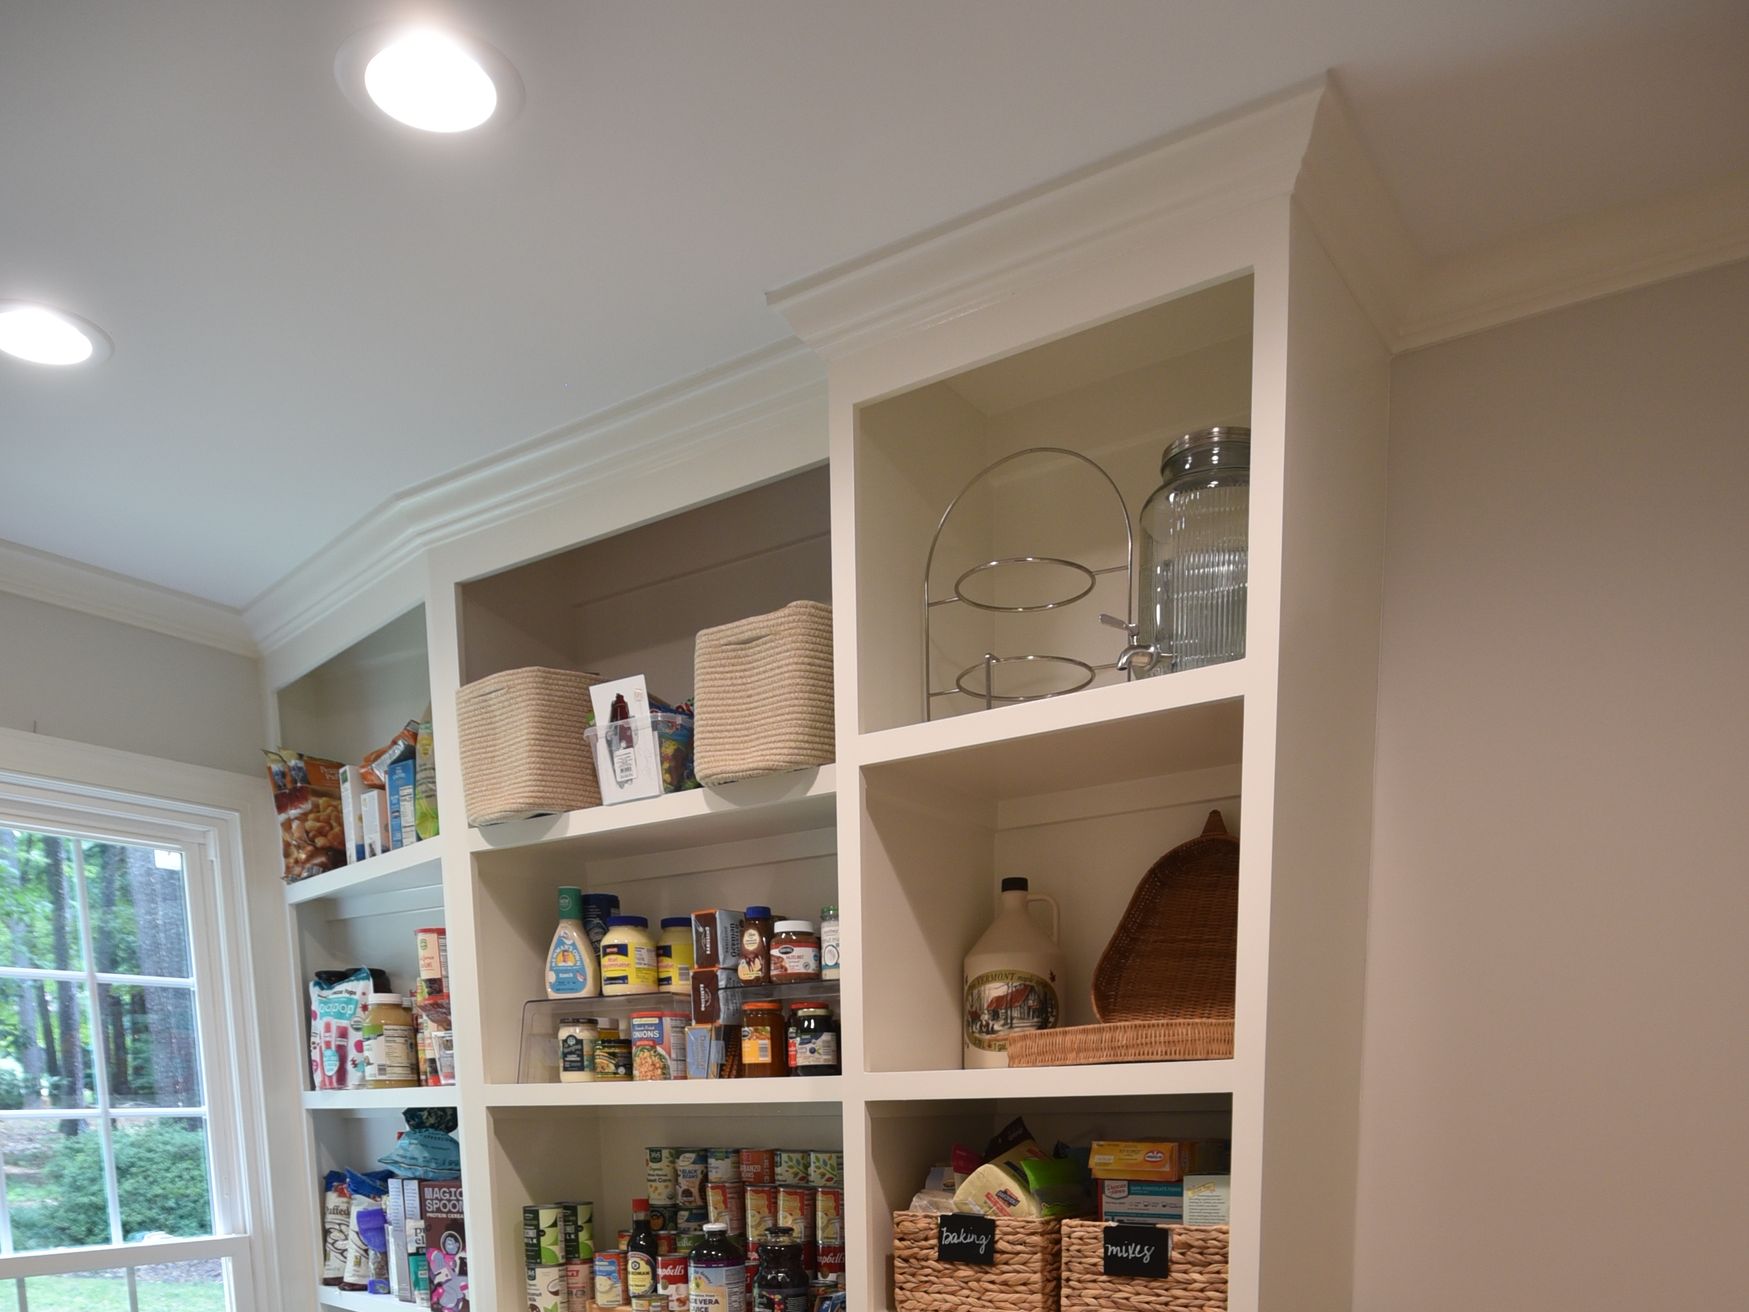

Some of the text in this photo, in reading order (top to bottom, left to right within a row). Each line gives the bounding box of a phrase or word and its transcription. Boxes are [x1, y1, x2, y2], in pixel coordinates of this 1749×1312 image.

[633, 1031, 660, 1039] ONIONS
[941, 1226, 991, 1254] baking
[1105, 1241, 1155, 1263] mixes
